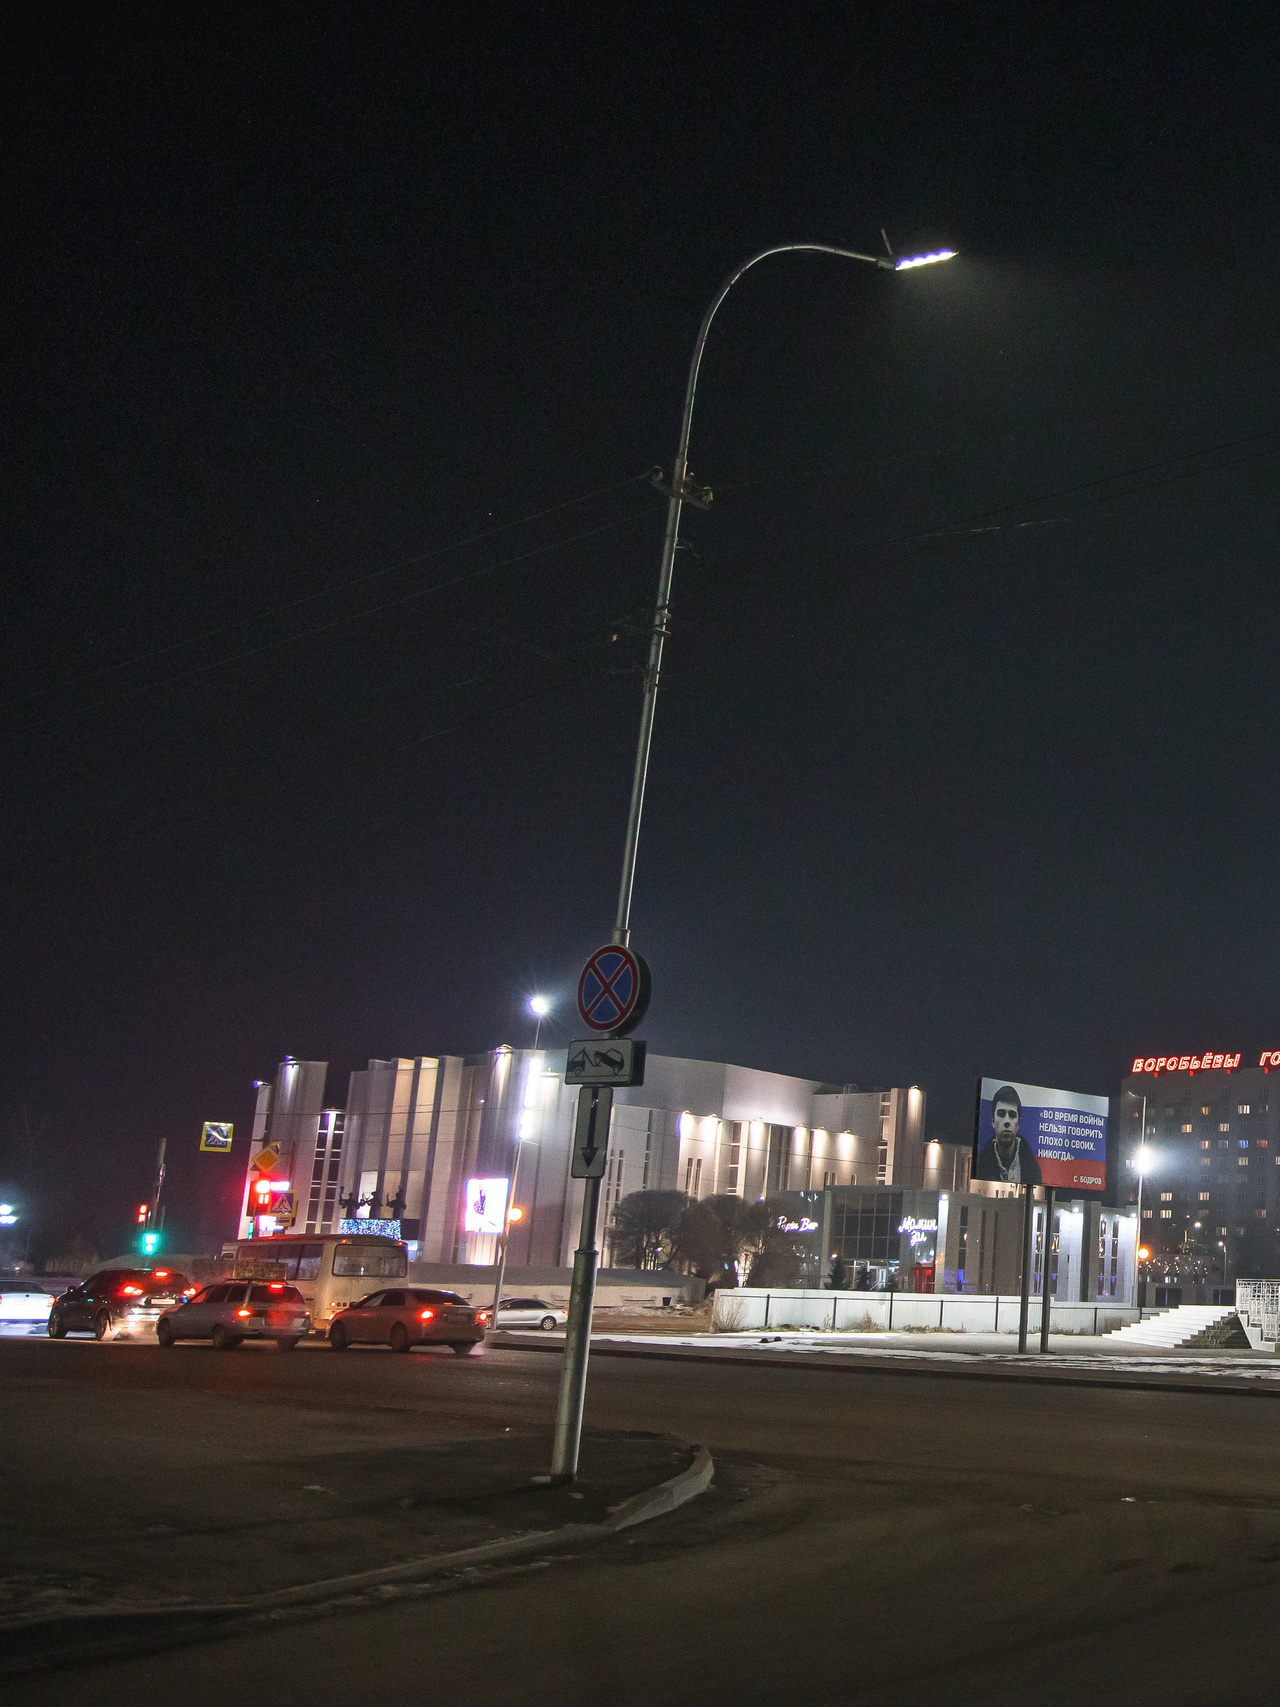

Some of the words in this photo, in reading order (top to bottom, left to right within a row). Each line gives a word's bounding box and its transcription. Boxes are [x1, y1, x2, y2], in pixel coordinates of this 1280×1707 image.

[1132, 1052, 1241, 1073] ВОРОБЬЁВЫ
[1055, 1112, 1078, 1122] ВРЕМЯ
[1080, 1115, 1104, 1126] ВОЙНЫ
[1039, 1123, 1066, 1134] НЕЛЬЗЯ
[1068, 1126, 1103, 1138] ГОВОРИТЬ
[1039, 1136, 1063, 1147] ПЛОХО
[1064, 1139, 1070, 1147] О
[1071, 1140, 1096, 1150] СВОИХ.
[1038, 1149, 1075, 1162] НИКОГДА»
[1080, 1176, 1102, 1185] БОДРОВ
